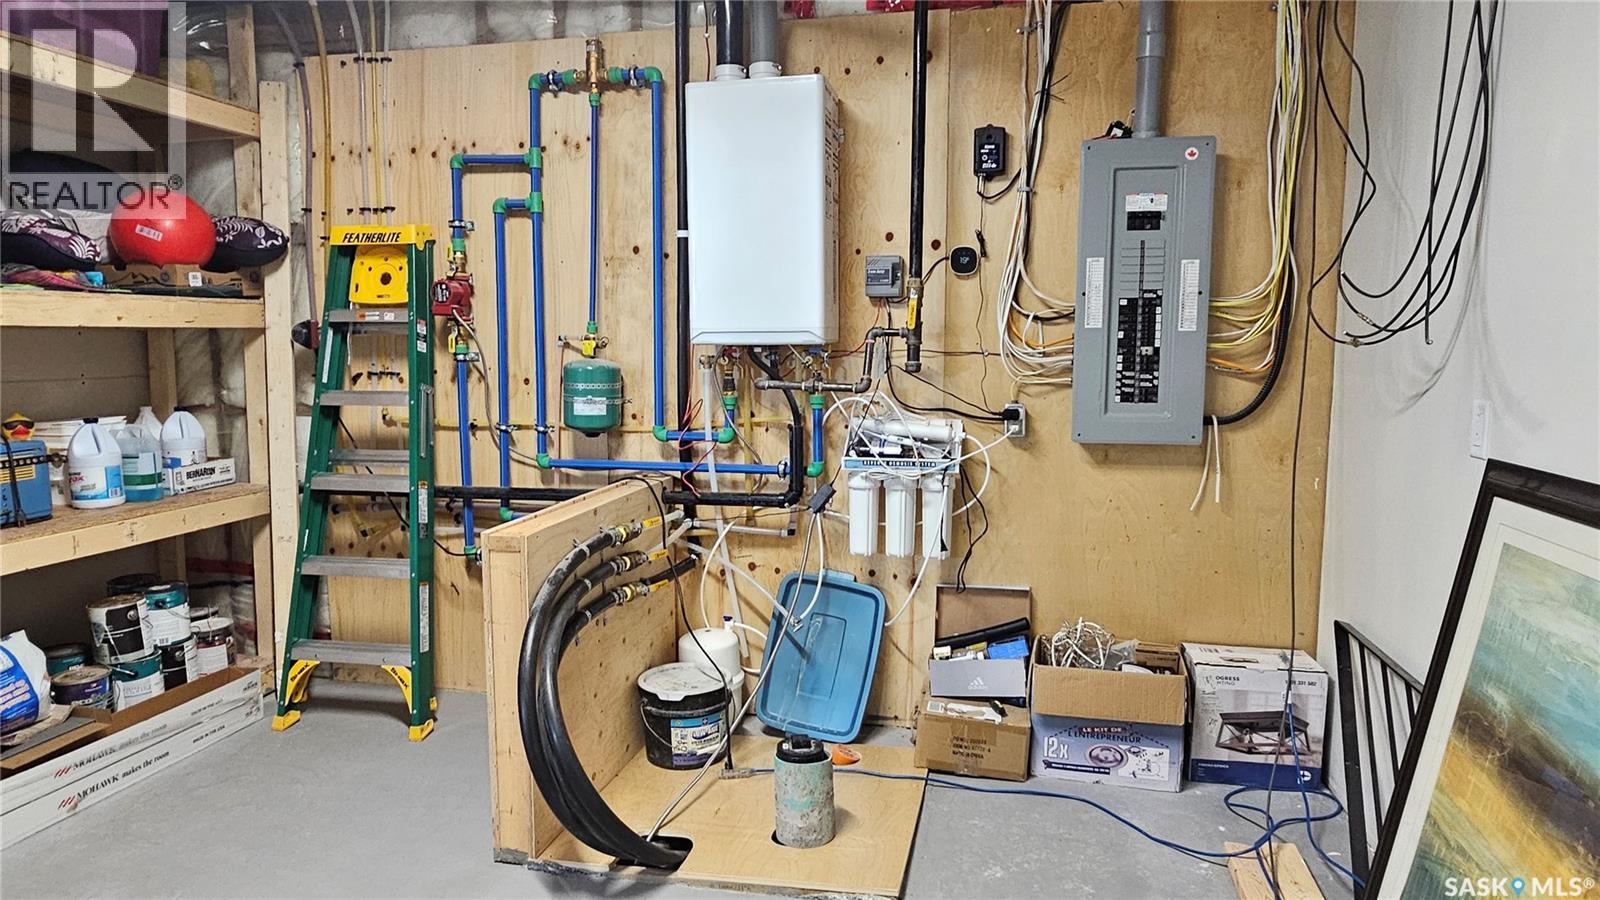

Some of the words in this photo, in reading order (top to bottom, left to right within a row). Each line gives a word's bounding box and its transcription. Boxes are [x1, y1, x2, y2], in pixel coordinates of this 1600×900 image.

[342, 232, 402, 243] FEATHERLITE
[76, 775, 120, 800] MOHAWK
[121, 765, 142, 778] makes
[143, 759, 153, 768] the
[154, 751, 170, 763] room
